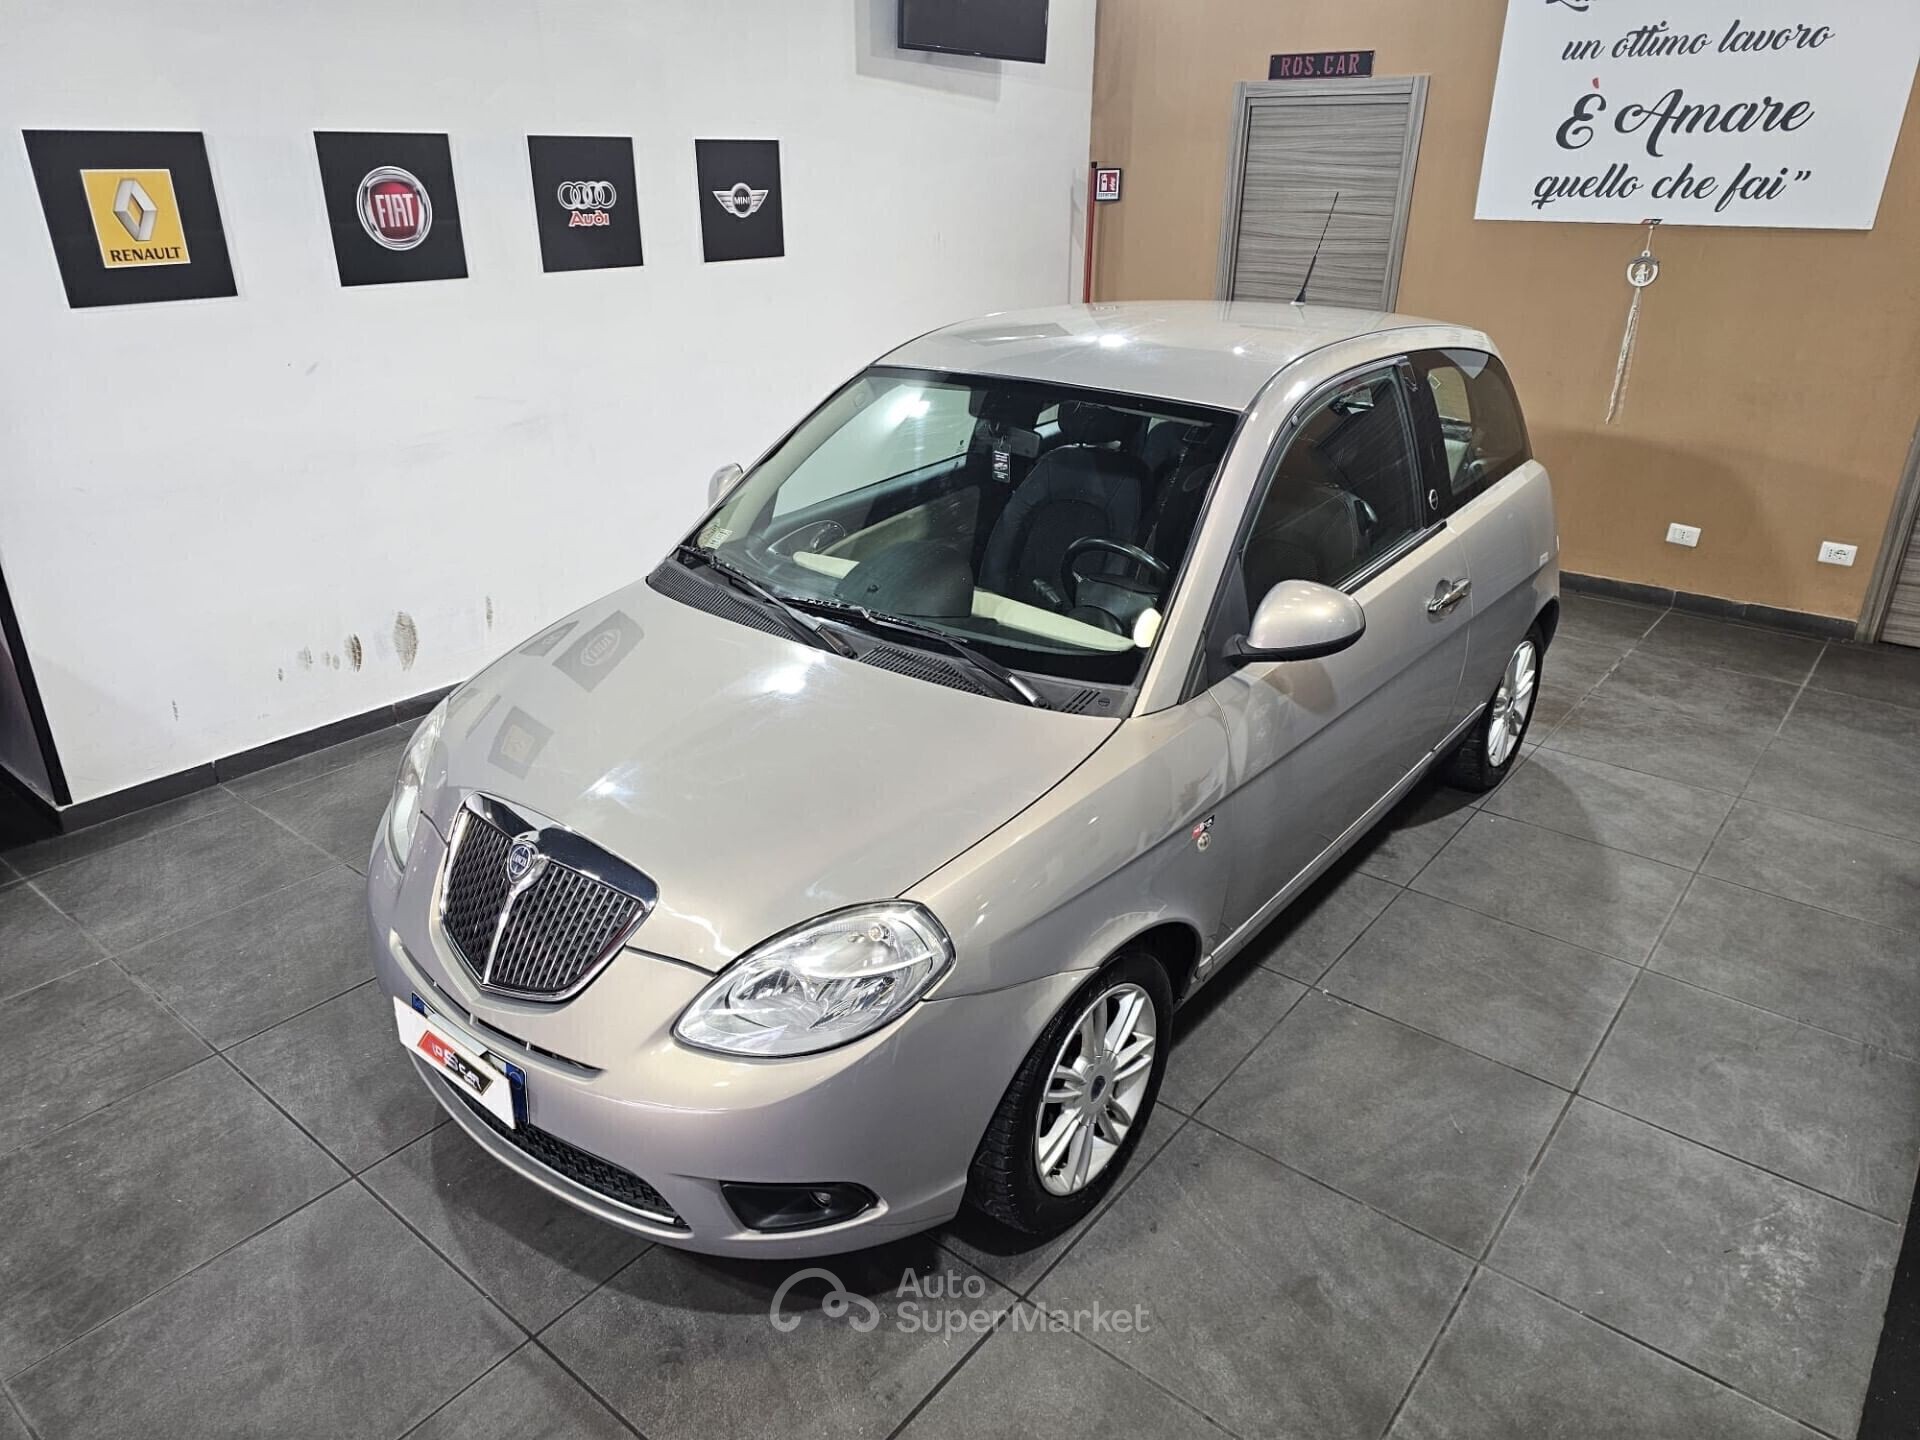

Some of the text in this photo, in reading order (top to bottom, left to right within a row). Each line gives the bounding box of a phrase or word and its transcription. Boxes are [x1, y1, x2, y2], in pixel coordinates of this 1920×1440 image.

[1562, 19, 1835, 60] un ottimo lavoro
[1614, 88, 1815, 157] Amare
[734, 196, 750, 205] MINI
[1532, 163, 1643, 209] quello
[1651, 163, 1718, 199] che
[375, 193, 416, 228] FIAT
[569, 210, 610, 227] Audi
[110, 246, 181, 263] RENAULT
